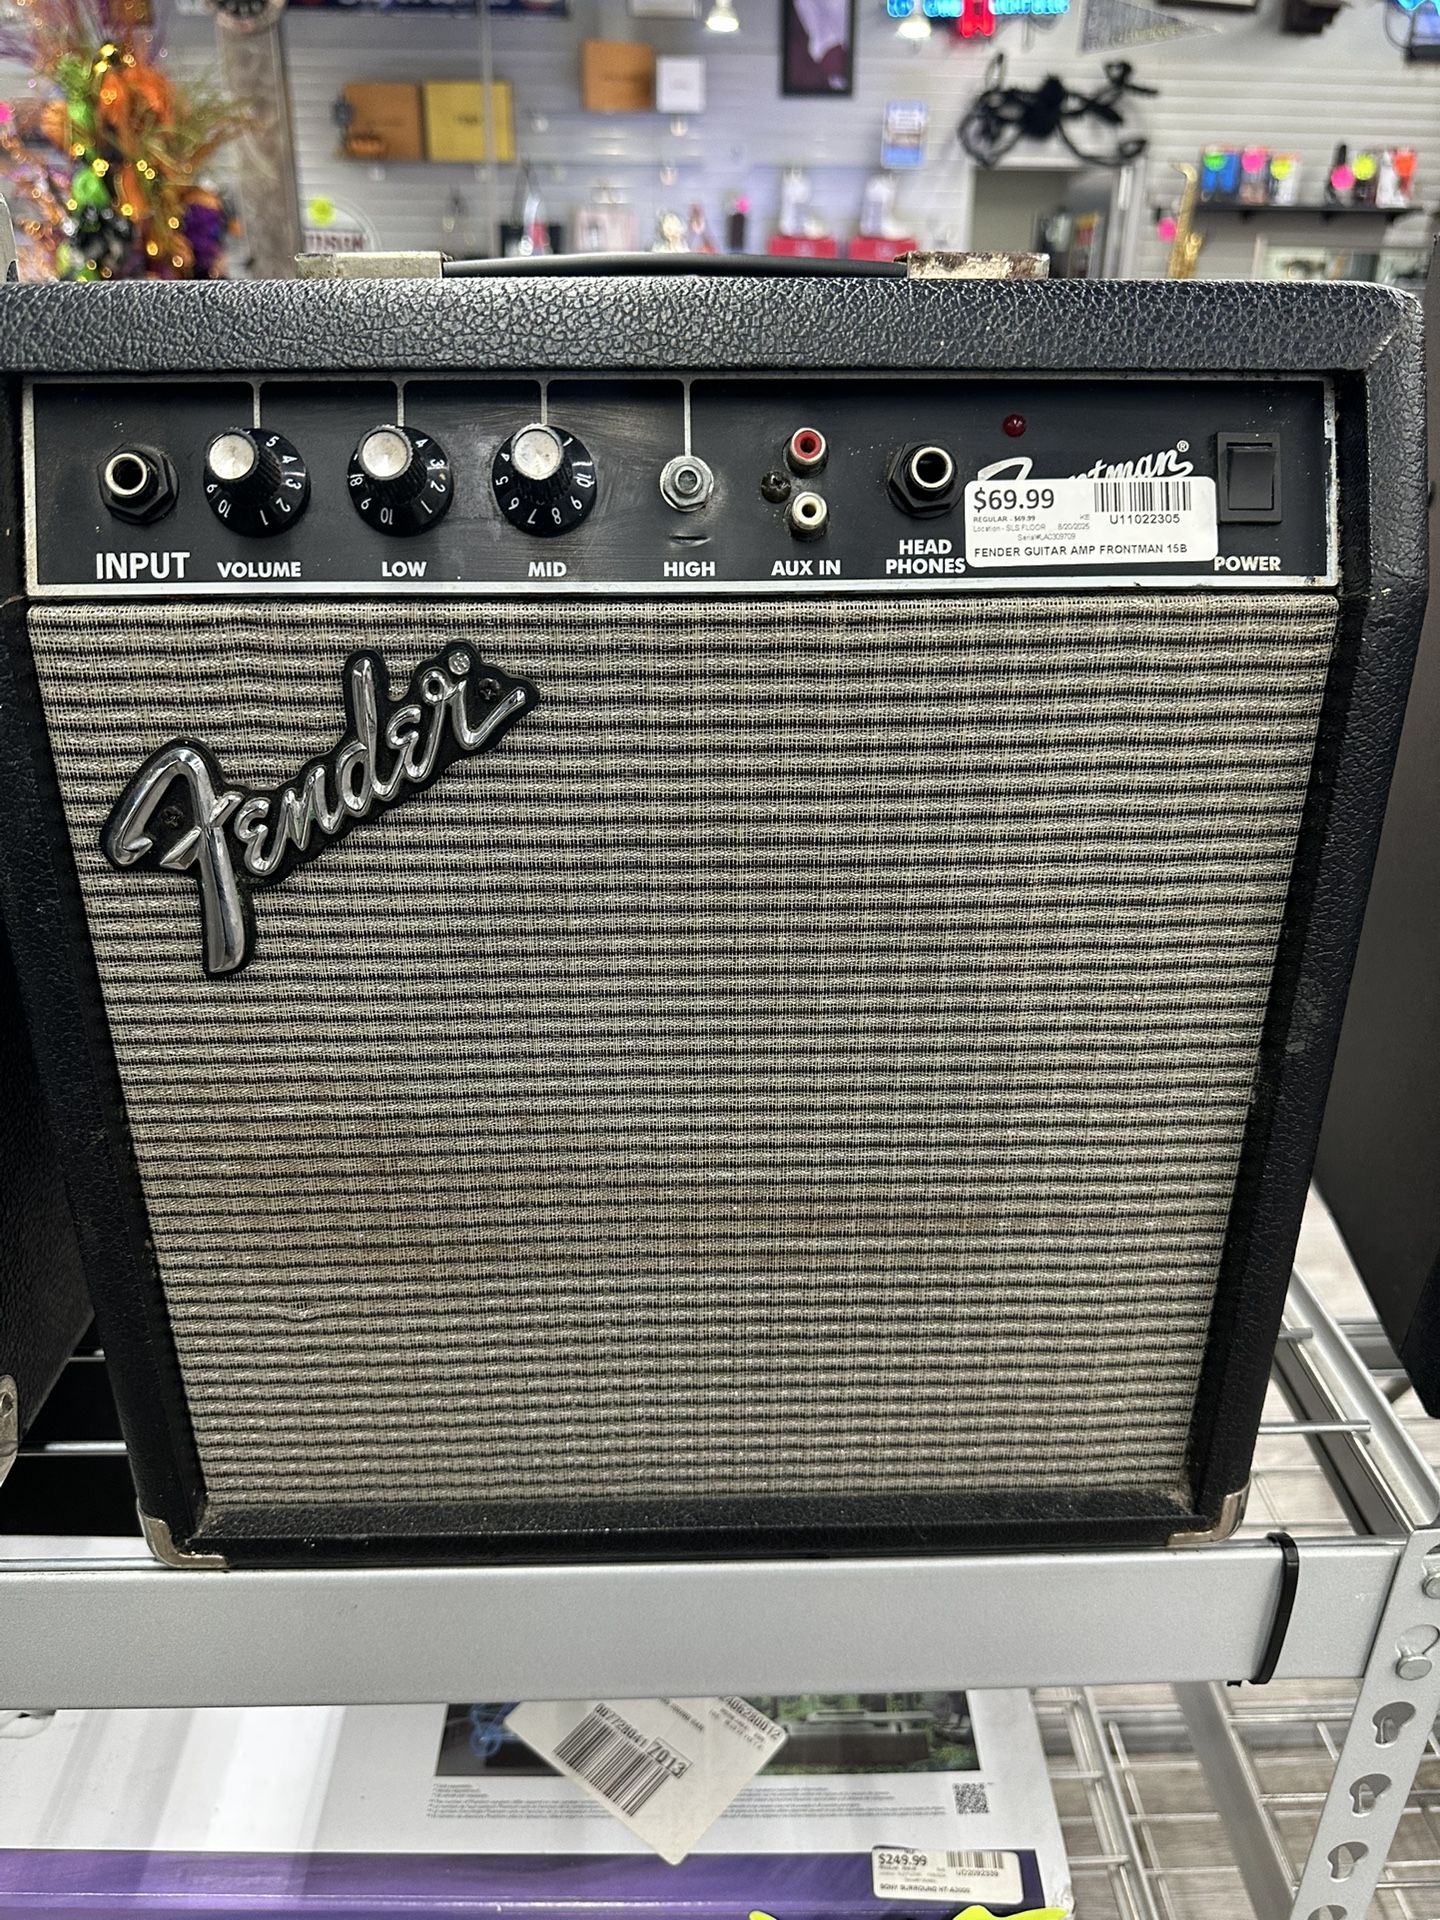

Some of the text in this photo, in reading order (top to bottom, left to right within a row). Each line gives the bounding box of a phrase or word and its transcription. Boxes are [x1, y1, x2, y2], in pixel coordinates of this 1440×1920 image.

[266, 435, 280, 448] 5
[415, 437, 428, 448] 4
[285, 478, 301, 490] 3
[430, 480, 446, 493] 2
[275, 498, 291, 513] 2
[495, 475, 509, 486] 5
[527, 508, 537, 525] 7
[551, 507, 562, 525] 8
[973, 487, 1055, 513] $69.99
[218, 499, 232, 518] 10
[380, 507, 393, 525] 10
[1021, 522, 1047, 531] FLOOR
[1109, 513, 1180, 525] U11022305
[899, 539, 952, 555] HEAD
[974, 543, 1188, 558] FENDER GUITAR AMP FRONTMAN 15B
[96, 552, 190, 580] INPUT
[217, 561, 302, 578] VOLUME
[381, 561, 427, 578] LOW
[528, 561, 567, 578] MID
[663, 561, 716, 577] HIGH
[771, 559, 841, 576] AUX IN
[885, 556, 966, 575] PHONES
[1213, 556, 1281, 571] POWER
[107, 656, 527, 975] Fender
[878, 1853, 927, 1866] $249.99
